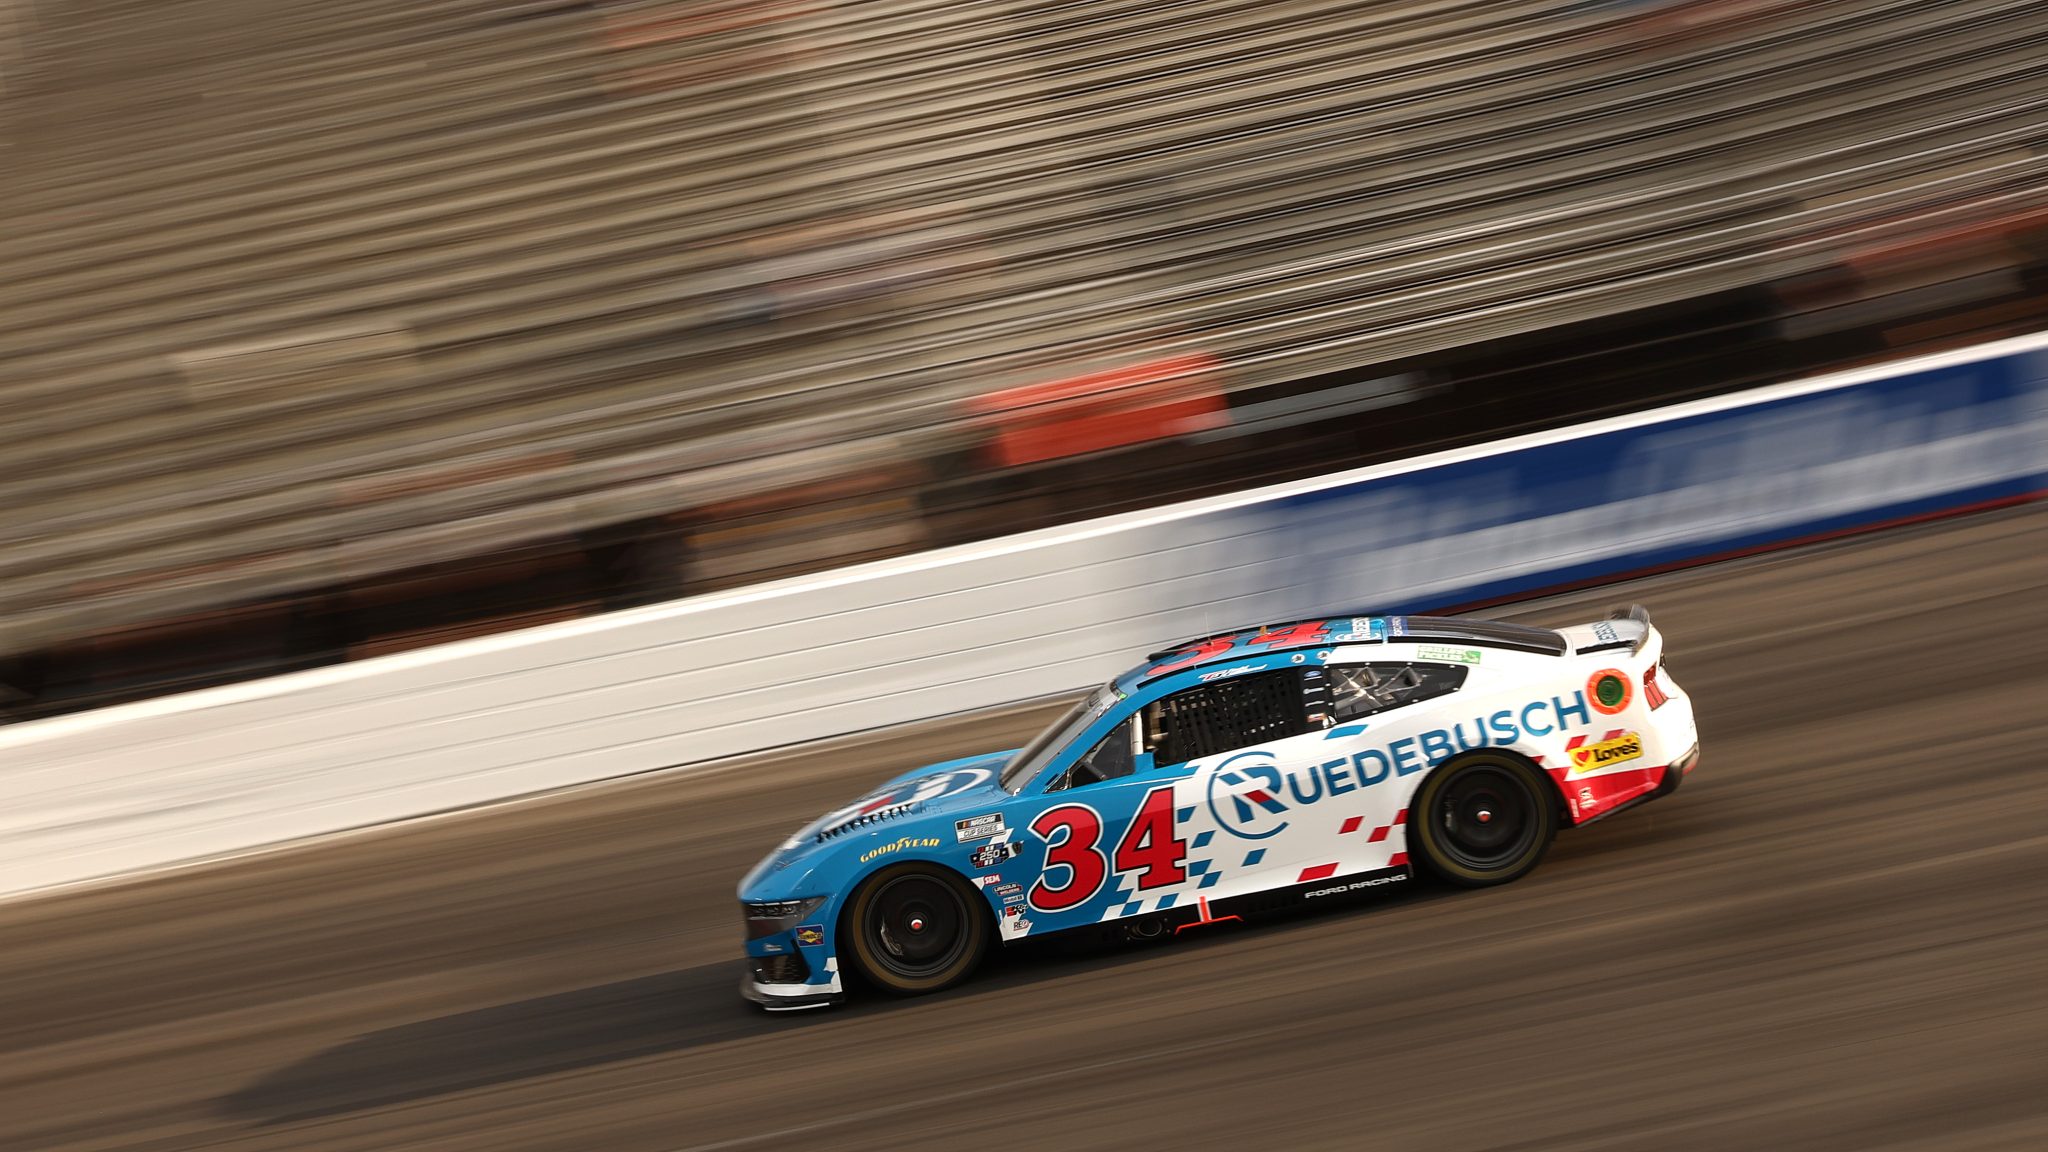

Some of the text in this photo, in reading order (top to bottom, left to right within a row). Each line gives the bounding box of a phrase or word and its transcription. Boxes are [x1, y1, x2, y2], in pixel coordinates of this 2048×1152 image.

[1212, 690, 1592, 825] RUEDEBUSCH
[970, 815, 996, 827] NASCAR
[963, 825, 998, 838] CUP SERIES
[860, 837, 940, 863] GOODYEAR
[980, 849, 1000, 861] 250
[1028, 784, 1187, 912] 34
[984, 874, 1000, 885] SEM
[1304, 874, 1408, 899] FORD RACING
